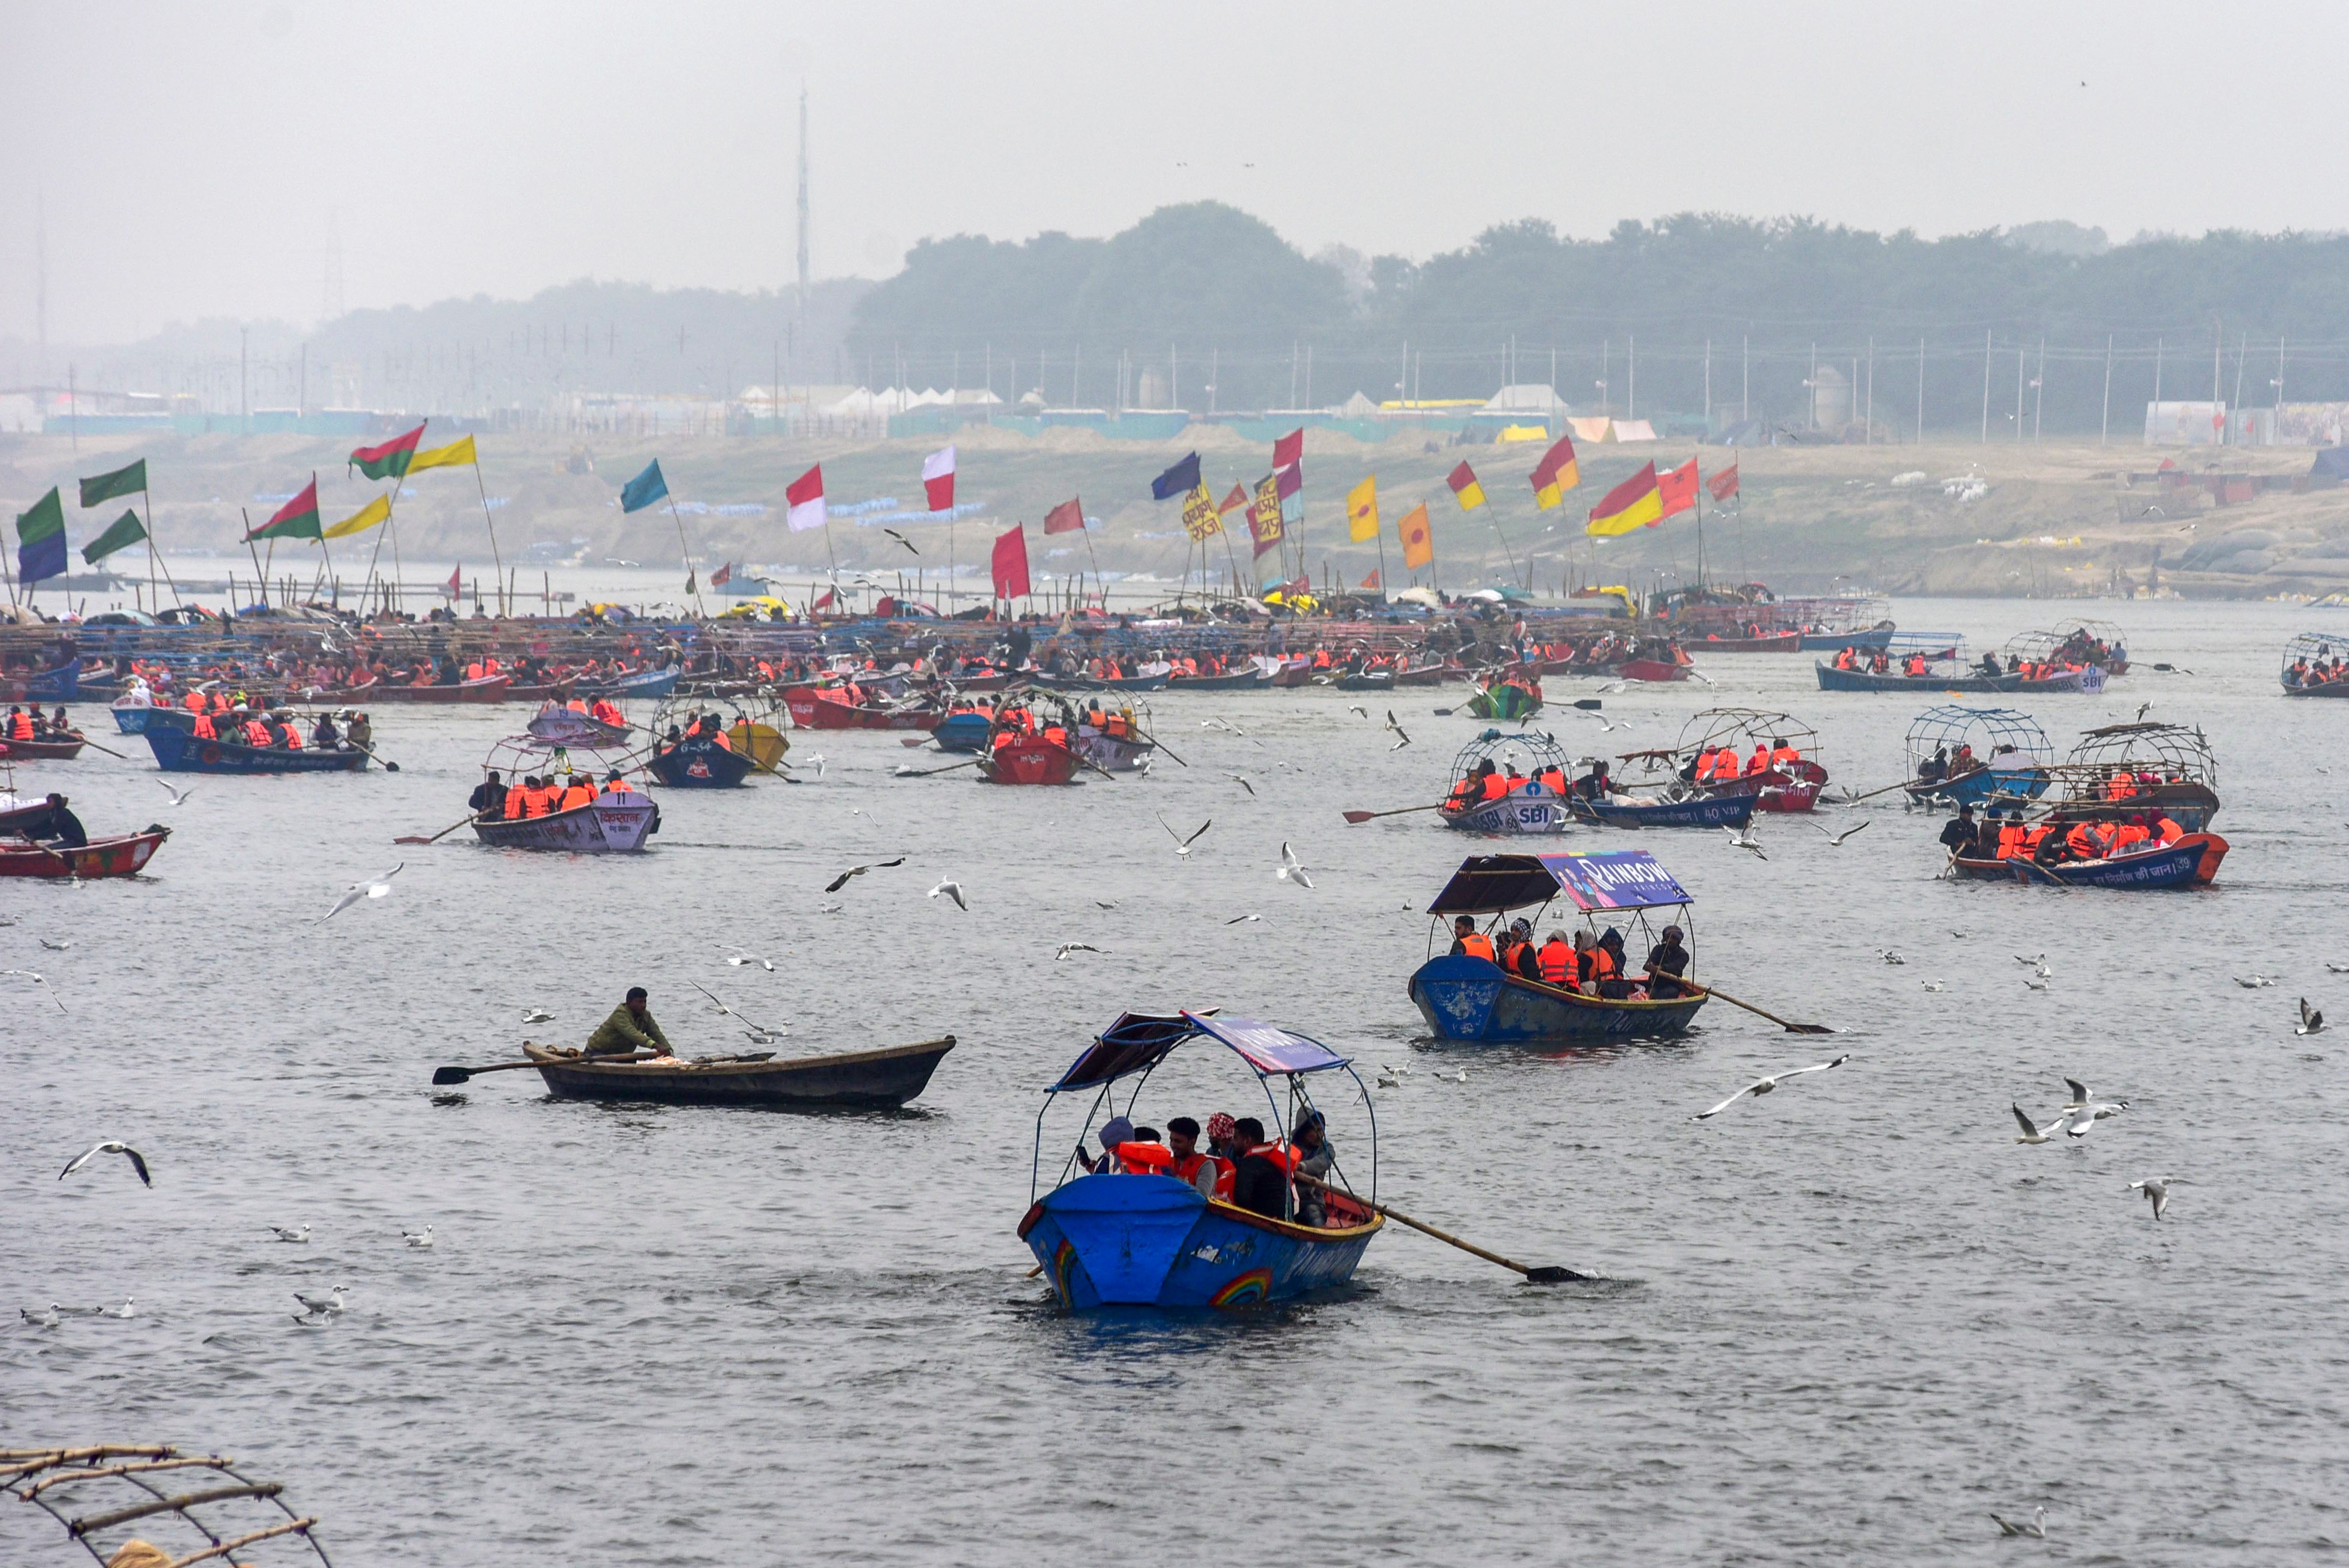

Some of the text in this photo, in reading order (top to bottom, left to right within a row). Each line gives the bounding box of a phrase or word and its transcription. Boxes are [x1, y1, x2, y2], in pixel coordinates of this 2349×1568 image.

[2083, 677, 2101, 687] SBI
[1014, 738, 1022, 747] 17
[616, 792, 626, 805] 11
[1520, 807, 1548, 823] SBI
[1705, 808, 1719, 819] 40
[1577, 859, 1671, 891] RAINBOW
[2135, 866, 2149, 880] की
